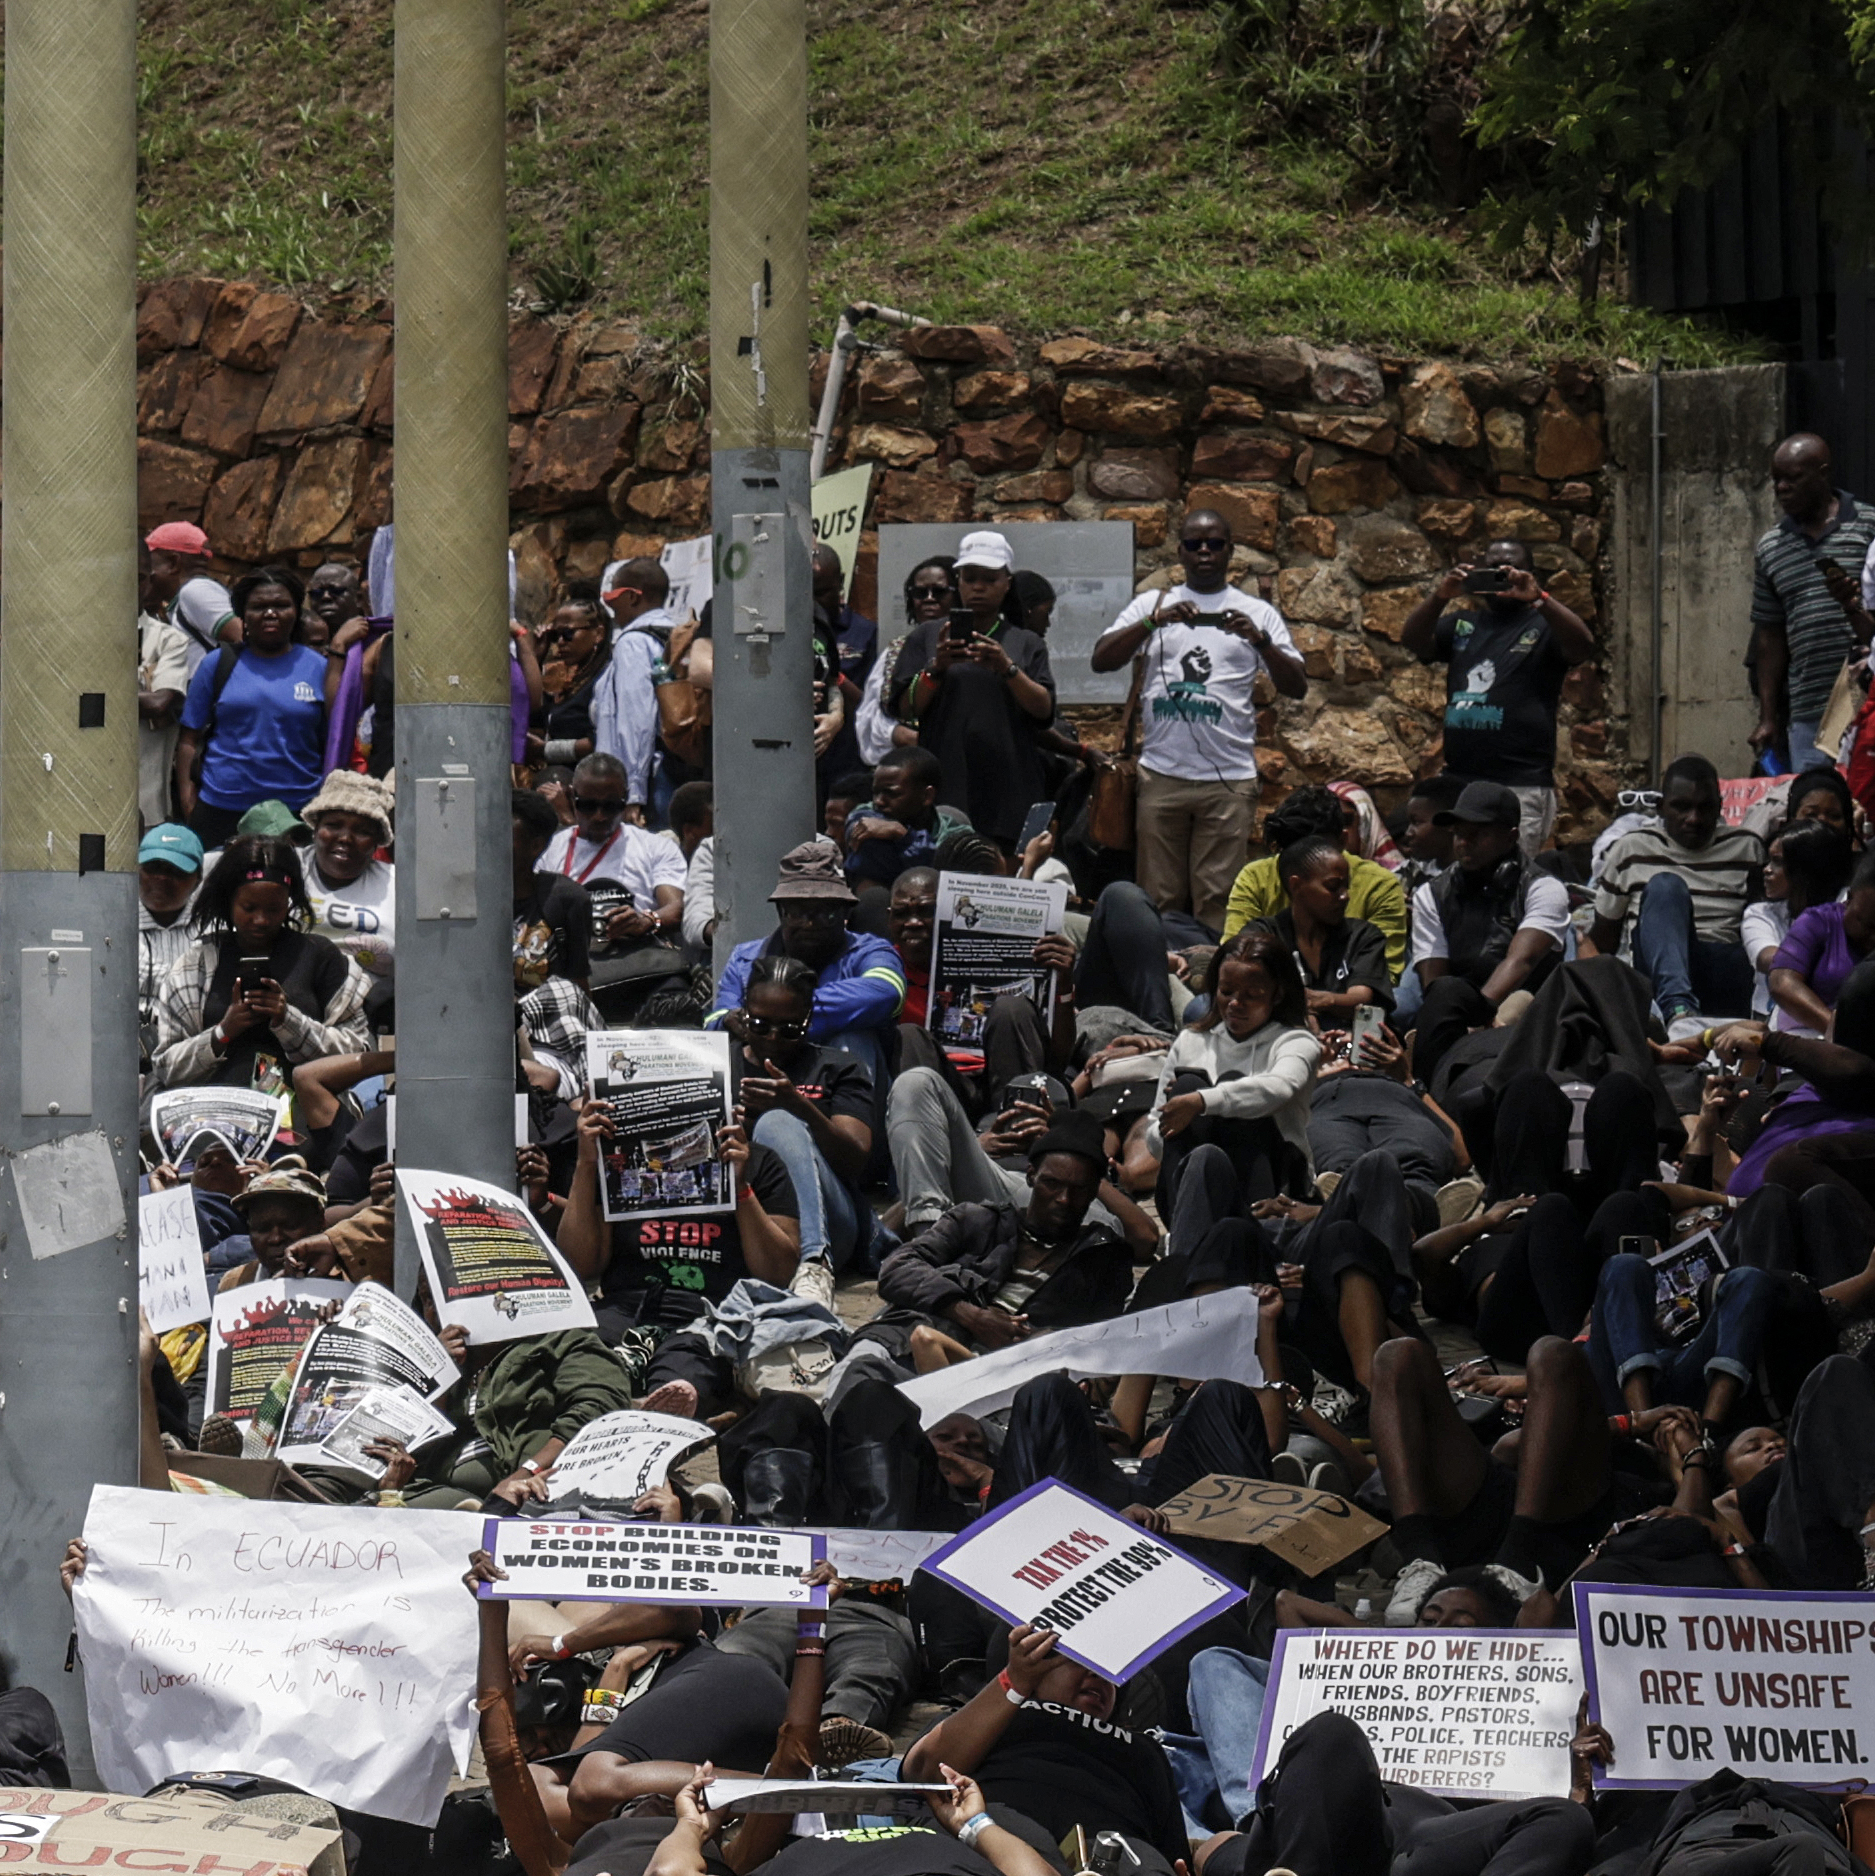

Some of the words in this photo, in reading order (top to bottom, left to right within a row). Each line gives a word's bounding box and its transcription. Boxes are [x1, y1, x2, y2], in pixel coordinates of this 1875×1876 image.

[639, 1220, 722, 1246] STOP
[640, 1246, 722, 1263] VIOLENCE
[564, 1442, 586, 1458] OUR
[588, 1435, 631, 1456] HEARTS
[578, 1449, 623, 1470] BROKEN
[1185, 1478, 1351, 1518] STOP
[528, 1524, 616, 1538] STOP
[623, 1527, 782, 1547] BUILDING
[138, 1522, 192, 1572] In
[234, 1532, 403, 1579] ECUADOR
[530, 1538, 726, 1558] ECONOMIES
[733, 1546, 779, 1560] ON
[1011, 1555, 1052, 1592] TAX
[1044, 1537, 1081, 1576] THE
[1073, 1527, 1110, 1562] 1%
[503, 1554, 663, 1572] WOMEN'S
[671, 1559, 805, 1579] BROKEN
[1100, 1555, 1143, 1598] THE
[1128, 1538, 1173, 1583] 99%
[586, 1574, 718, 1593] BODIES.
[132, 1598, 175, 1617] The
[188, 1596, 355, 1621] militarization
[1598, 1610, 1667, 1650] OUR
[130, 1628, 197, 1653] Killing
[218, 1638, 263, 1658] the
[1314, 1639, 1401, 1661] WHERE
[1405, 1640, 1436, 1661] DO
[1446, 1640, 1482, 1661] WE
[1489, 1641, 1564, 1663] HIDE...
[257, 1672, 297, 1694] No
[1299, 1663, 1353, 1680] WHEN
[1359, 1663, 1398, 1680] OUR
[1403, 1664, 1509, 1683] BROTHERS,
[1516, 1666, 1574, 1684] SONS,
[1322, 1685, 1409, 1702] FRIENDS,
[1416, 1685, 1540, 1705] BOYFRIENDS,
[1639, 1669, 1703, 1707] ARE
[1716, 1671, 1853, 1710] UNSAFE
[1019, 1698, 1134, 1745] ACTION
[1442, 1707, 1535, 1725] PASTORS,
[1391, 1727, 1464, 1745] POLICE,
[1647, 1724, 1715, 1761] FOR
[1726, 1725, 1869, 1765] WOMEN.
[1382, 1747, 1419, 1764] THE
[1423, 1749, 1506, 1768] RAPISTS
